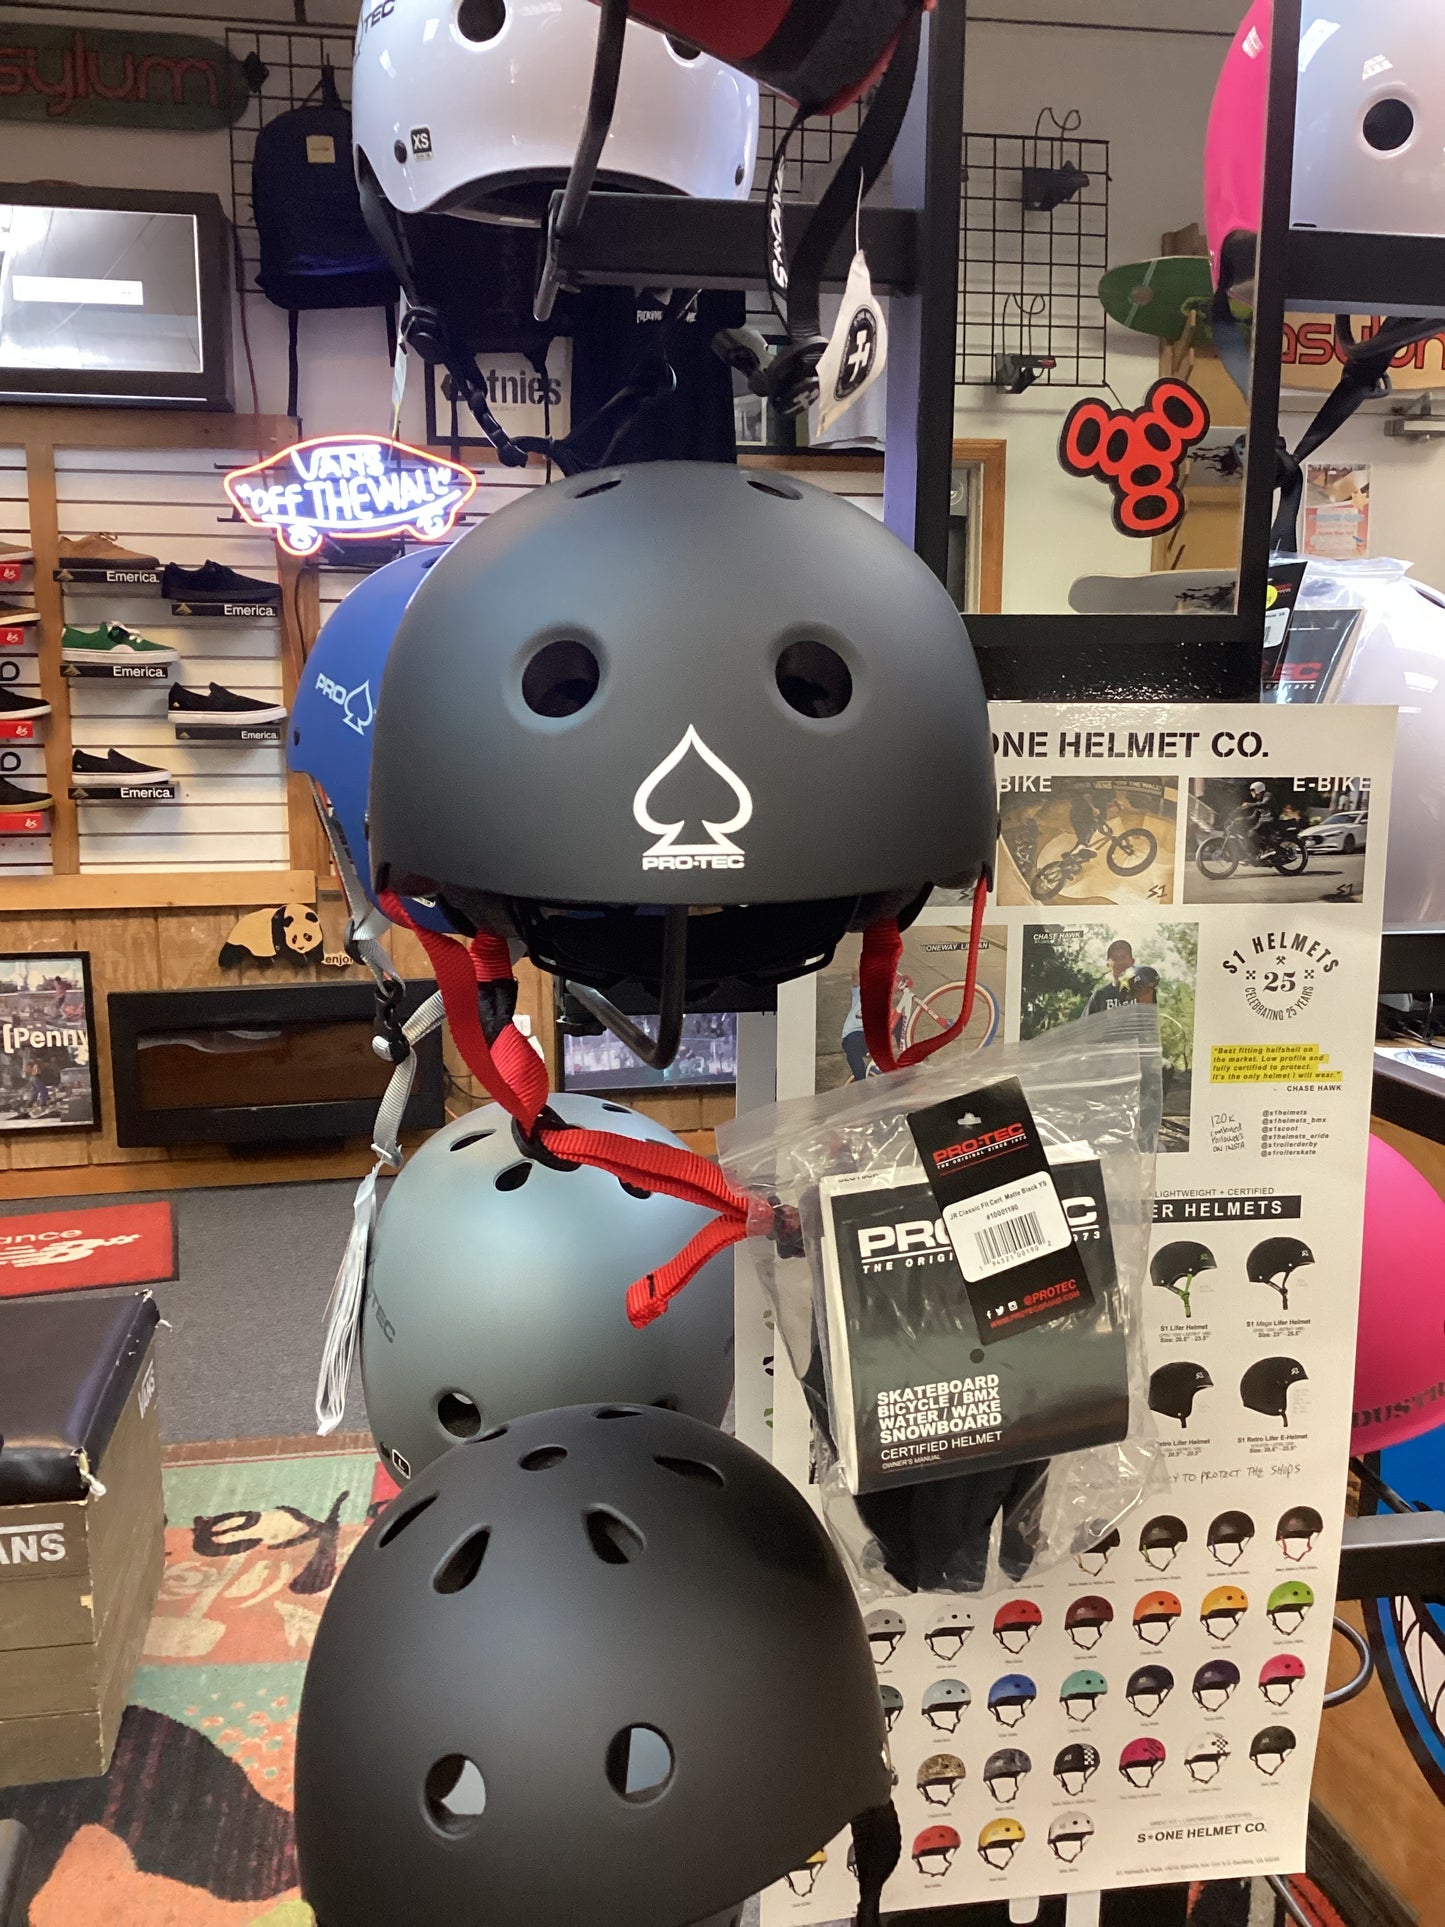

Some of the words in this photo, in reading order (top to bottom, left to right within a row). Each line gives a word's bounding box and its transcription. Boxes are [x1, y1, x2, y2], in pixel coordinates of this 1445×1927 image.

[413, 133, 429, 150] XS
[291, 445, 384, 481] VANS
[304, 479, 374, 521] THE
[106, 570, 160, 583] Emerica.
[224, 604, 276, 616] Emerica.
[113, 665, 166, 678] Emerica.
[315, 672, 347, 705] PRO
[241, 731, 279, 740] Emerica.
[1059, 731, 1200, 758] HELMET
[1211, 731, 1269, 758] CO.
[121, 787, 173, 799] Emerica.
[1000, 776, 1052, 793] BIKE
[1293, 777, 1371, 792] E-BIKE
[1033, 932, 1058, 940] CHASE
[926, 944, 957, 952] ONEWAY
[1222, 950, 1246, 974] S1
[1252, 931, 1339, 973] HELMETS
[1263, 971, 1296, 993] 25
[1245, 987, 1284, 1020] CELEBRATING
[1286, 1006, 1297, 1018] 25
[1295, 986, 1314, 1010] YEARS
[1239, 1047, 1263, 1055] fitting
[950, 1212, 958, 1221] JR
[959, 1206, 981, 1217] Classic
[981, 1201, 989, 1209] Fit
[1004, 1191, 1021, 1200] Matte
[1021, 1184, 1038, 1194] Black
[1039, 1180, 1048, 1188] YS
[1155, 1188, 1217, 1198] LIGHTWEIGHT
[1227, 1187, 1275, 1196] CERTIFIED
[1185, 1200, 1282, 1218] HELMETS
[863, 1261, 893, 1274] THE
[905, 1253, 953, 1268] ORIGI
[1023, 1279, 1076, 1305] @PROTEC
[877, 1374, 999, 1405] SKATEBOARD
[878, 1395, 950, 1418] BICYCLE
[963, 1387, 1000, 1404] BMX
[879, 1410, 939, 1430] WATER
[952, 1400, 1001, 1418] WAKE
[880, 1412, 1002, 1444] SNOWBOARD
[881, 1440, 948, 1460] CERTIFIED
[951, 1431, 1003, 1449] HELMET
[882, 1457, 913, 1470] OWNER'S
[914, 1454, 941, 1464] MANUAL
[1183, 1473, 1197, 1482] TO
[1200, 1469, 1240, 1484] PROTECT
[1187, 1824, 1241, 1839] HELMET
[1244, 1822, 1267, 1834] CO.
